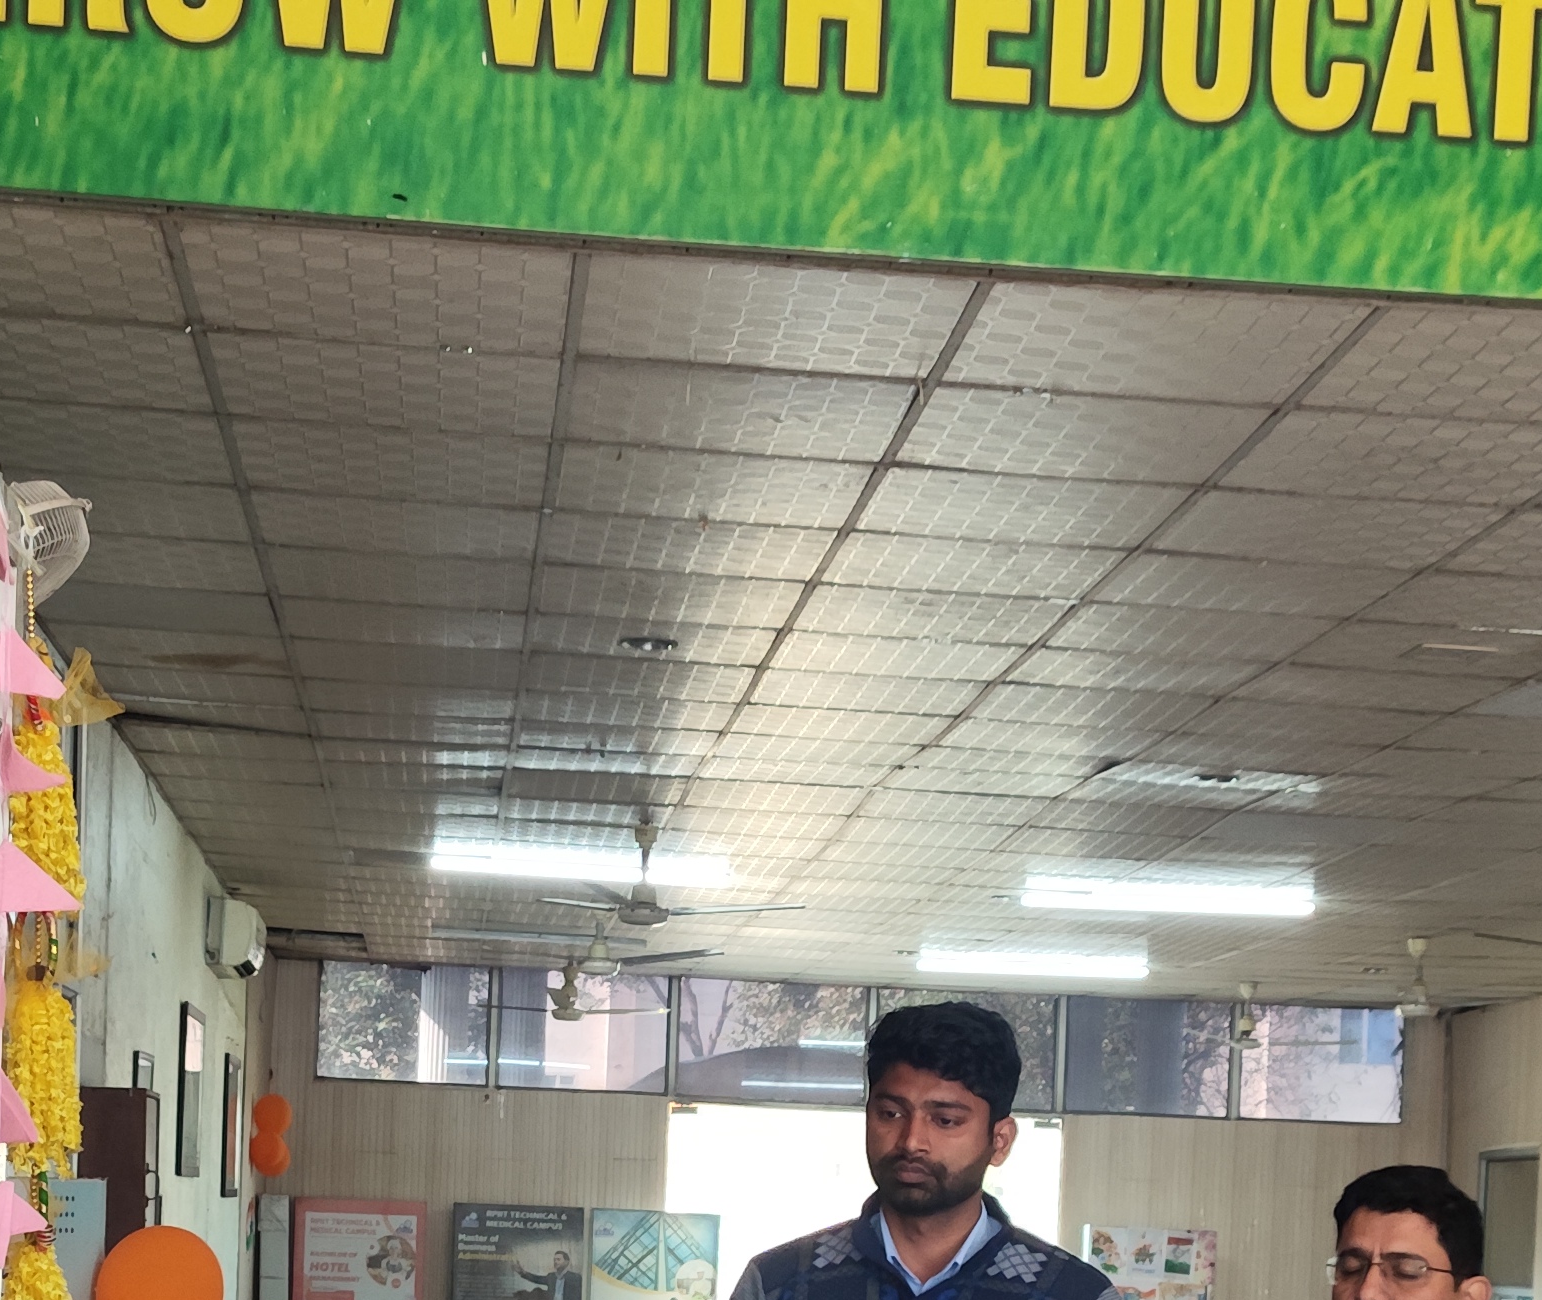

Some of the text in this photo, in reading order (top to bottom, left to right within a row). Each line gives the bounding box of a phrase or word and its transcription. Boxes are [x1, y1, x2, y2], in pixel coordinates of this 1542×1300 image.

[510, 1211, 559, 1220] TECHNICAL
[485, 1220, 524, 1229] MEDICAL
[309, 1262, 351, 1273] HOTEL
